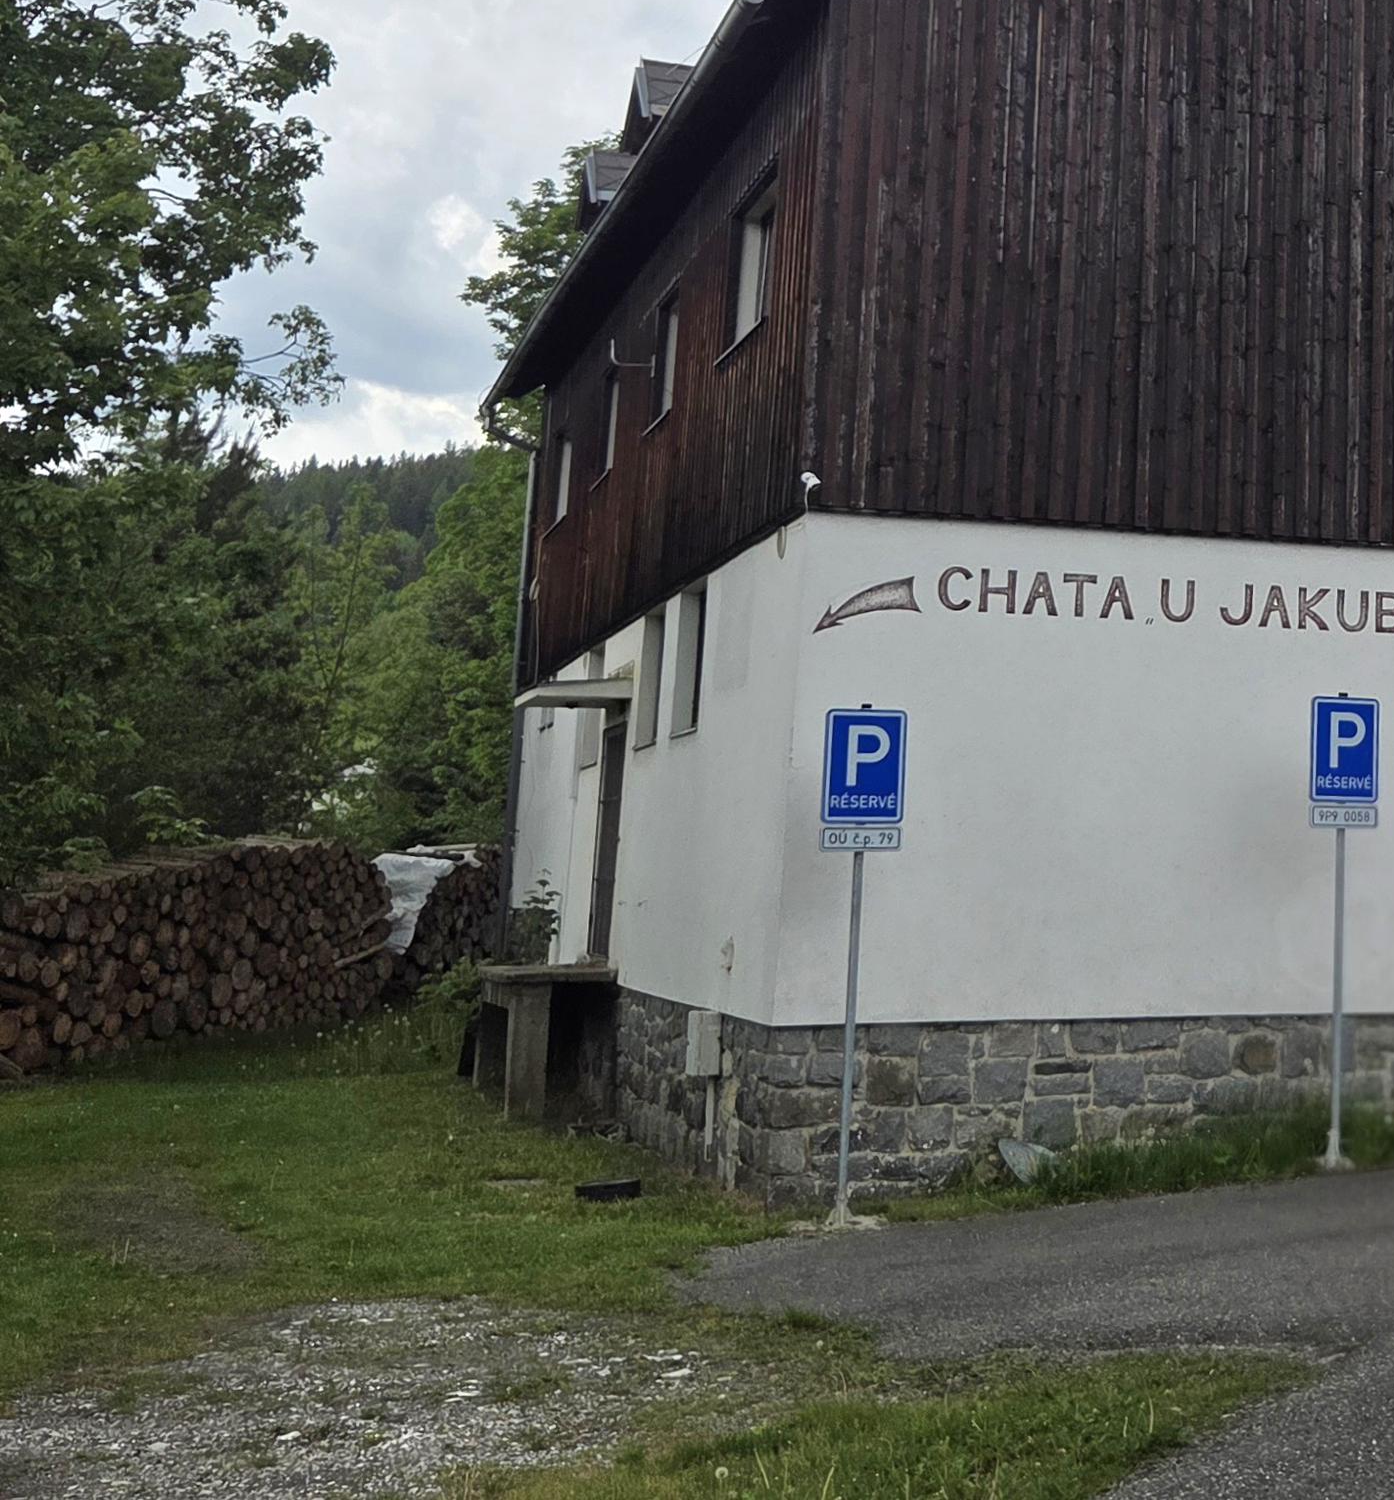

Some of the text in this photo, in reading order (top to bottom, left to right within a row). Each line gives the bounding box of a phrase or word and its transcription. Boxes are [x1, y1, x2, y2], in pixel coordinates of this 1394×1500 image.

[938, 566, 1134, 620] CHATA
[1329, 711, 1366, 768] P
[845, 724, 891, 787] P
[1316, 772, 1372, 790] RÉSERVÉ
[829, 791, 897, 809] RÉSERVÉ
[1318, 809, 1338, 821] 9P9
[828, 829, 847, 845] OÚ
[878, 832, 894, 845] 79
